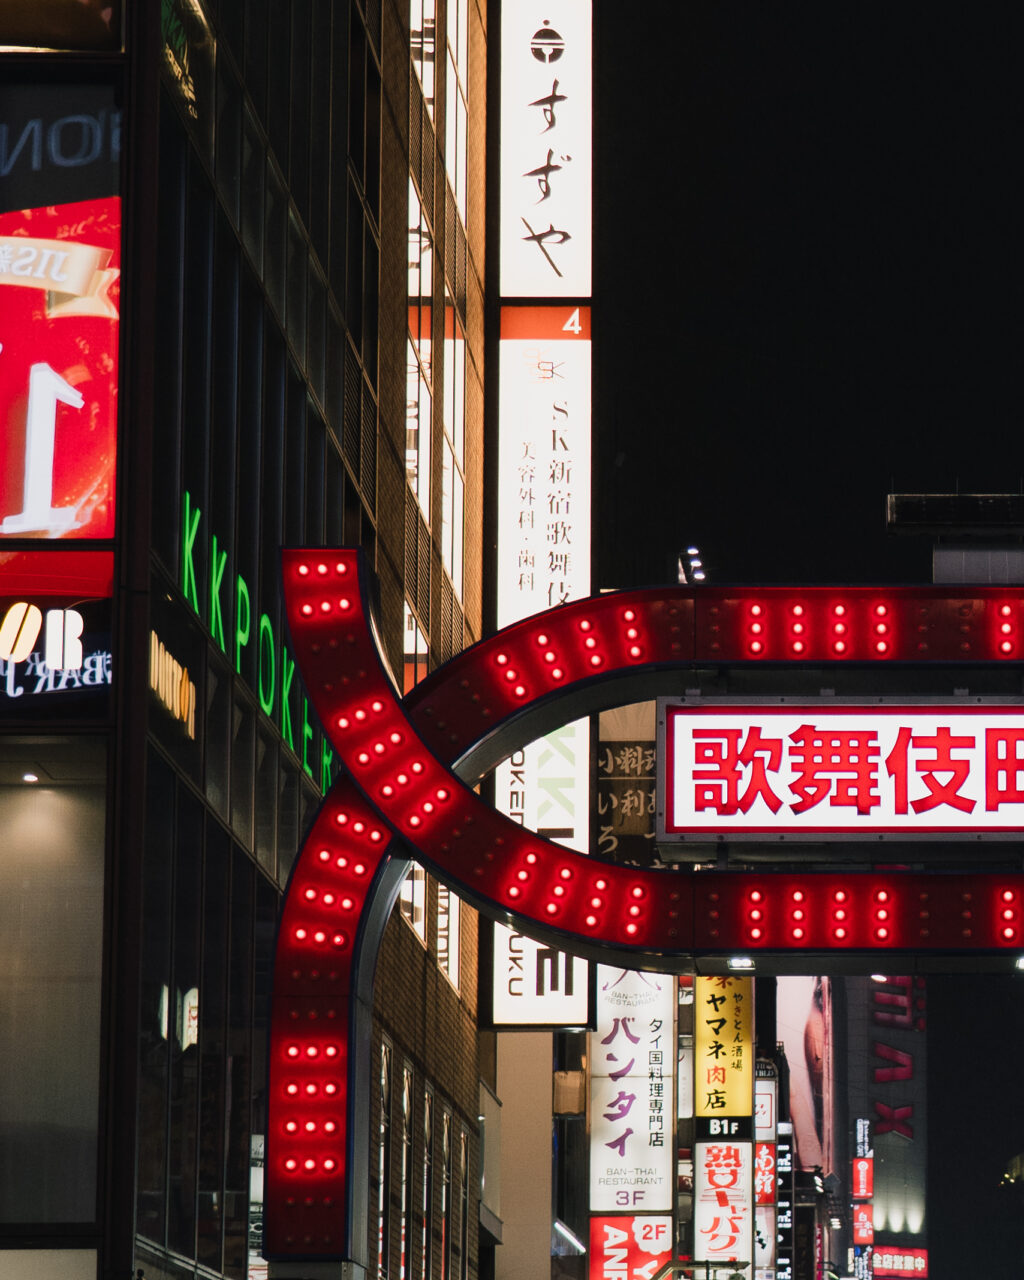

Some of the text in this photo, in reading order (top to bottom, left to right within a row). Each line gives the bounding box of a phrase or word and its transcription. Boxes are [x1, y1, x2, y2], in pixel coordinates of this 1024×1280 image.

[520, 78, 573, 278] すずや
[562, 309, 582, 334] 4
[704, 993, 728, 1111] ヤマネ肉店
[600, 1016, 641, 1158] バンタイ
[648, 1018, 664, 1148] タイ国料理専門店
[709, 1119, 739, 1135] B1F
[598, 1177, 664, 1186] RESTAURANT
[606, 1167, 657, 1177] BAN-THAI
[615, 1190, 646, 1206] 3F
[642, 1223, 667, 1241] 2F
